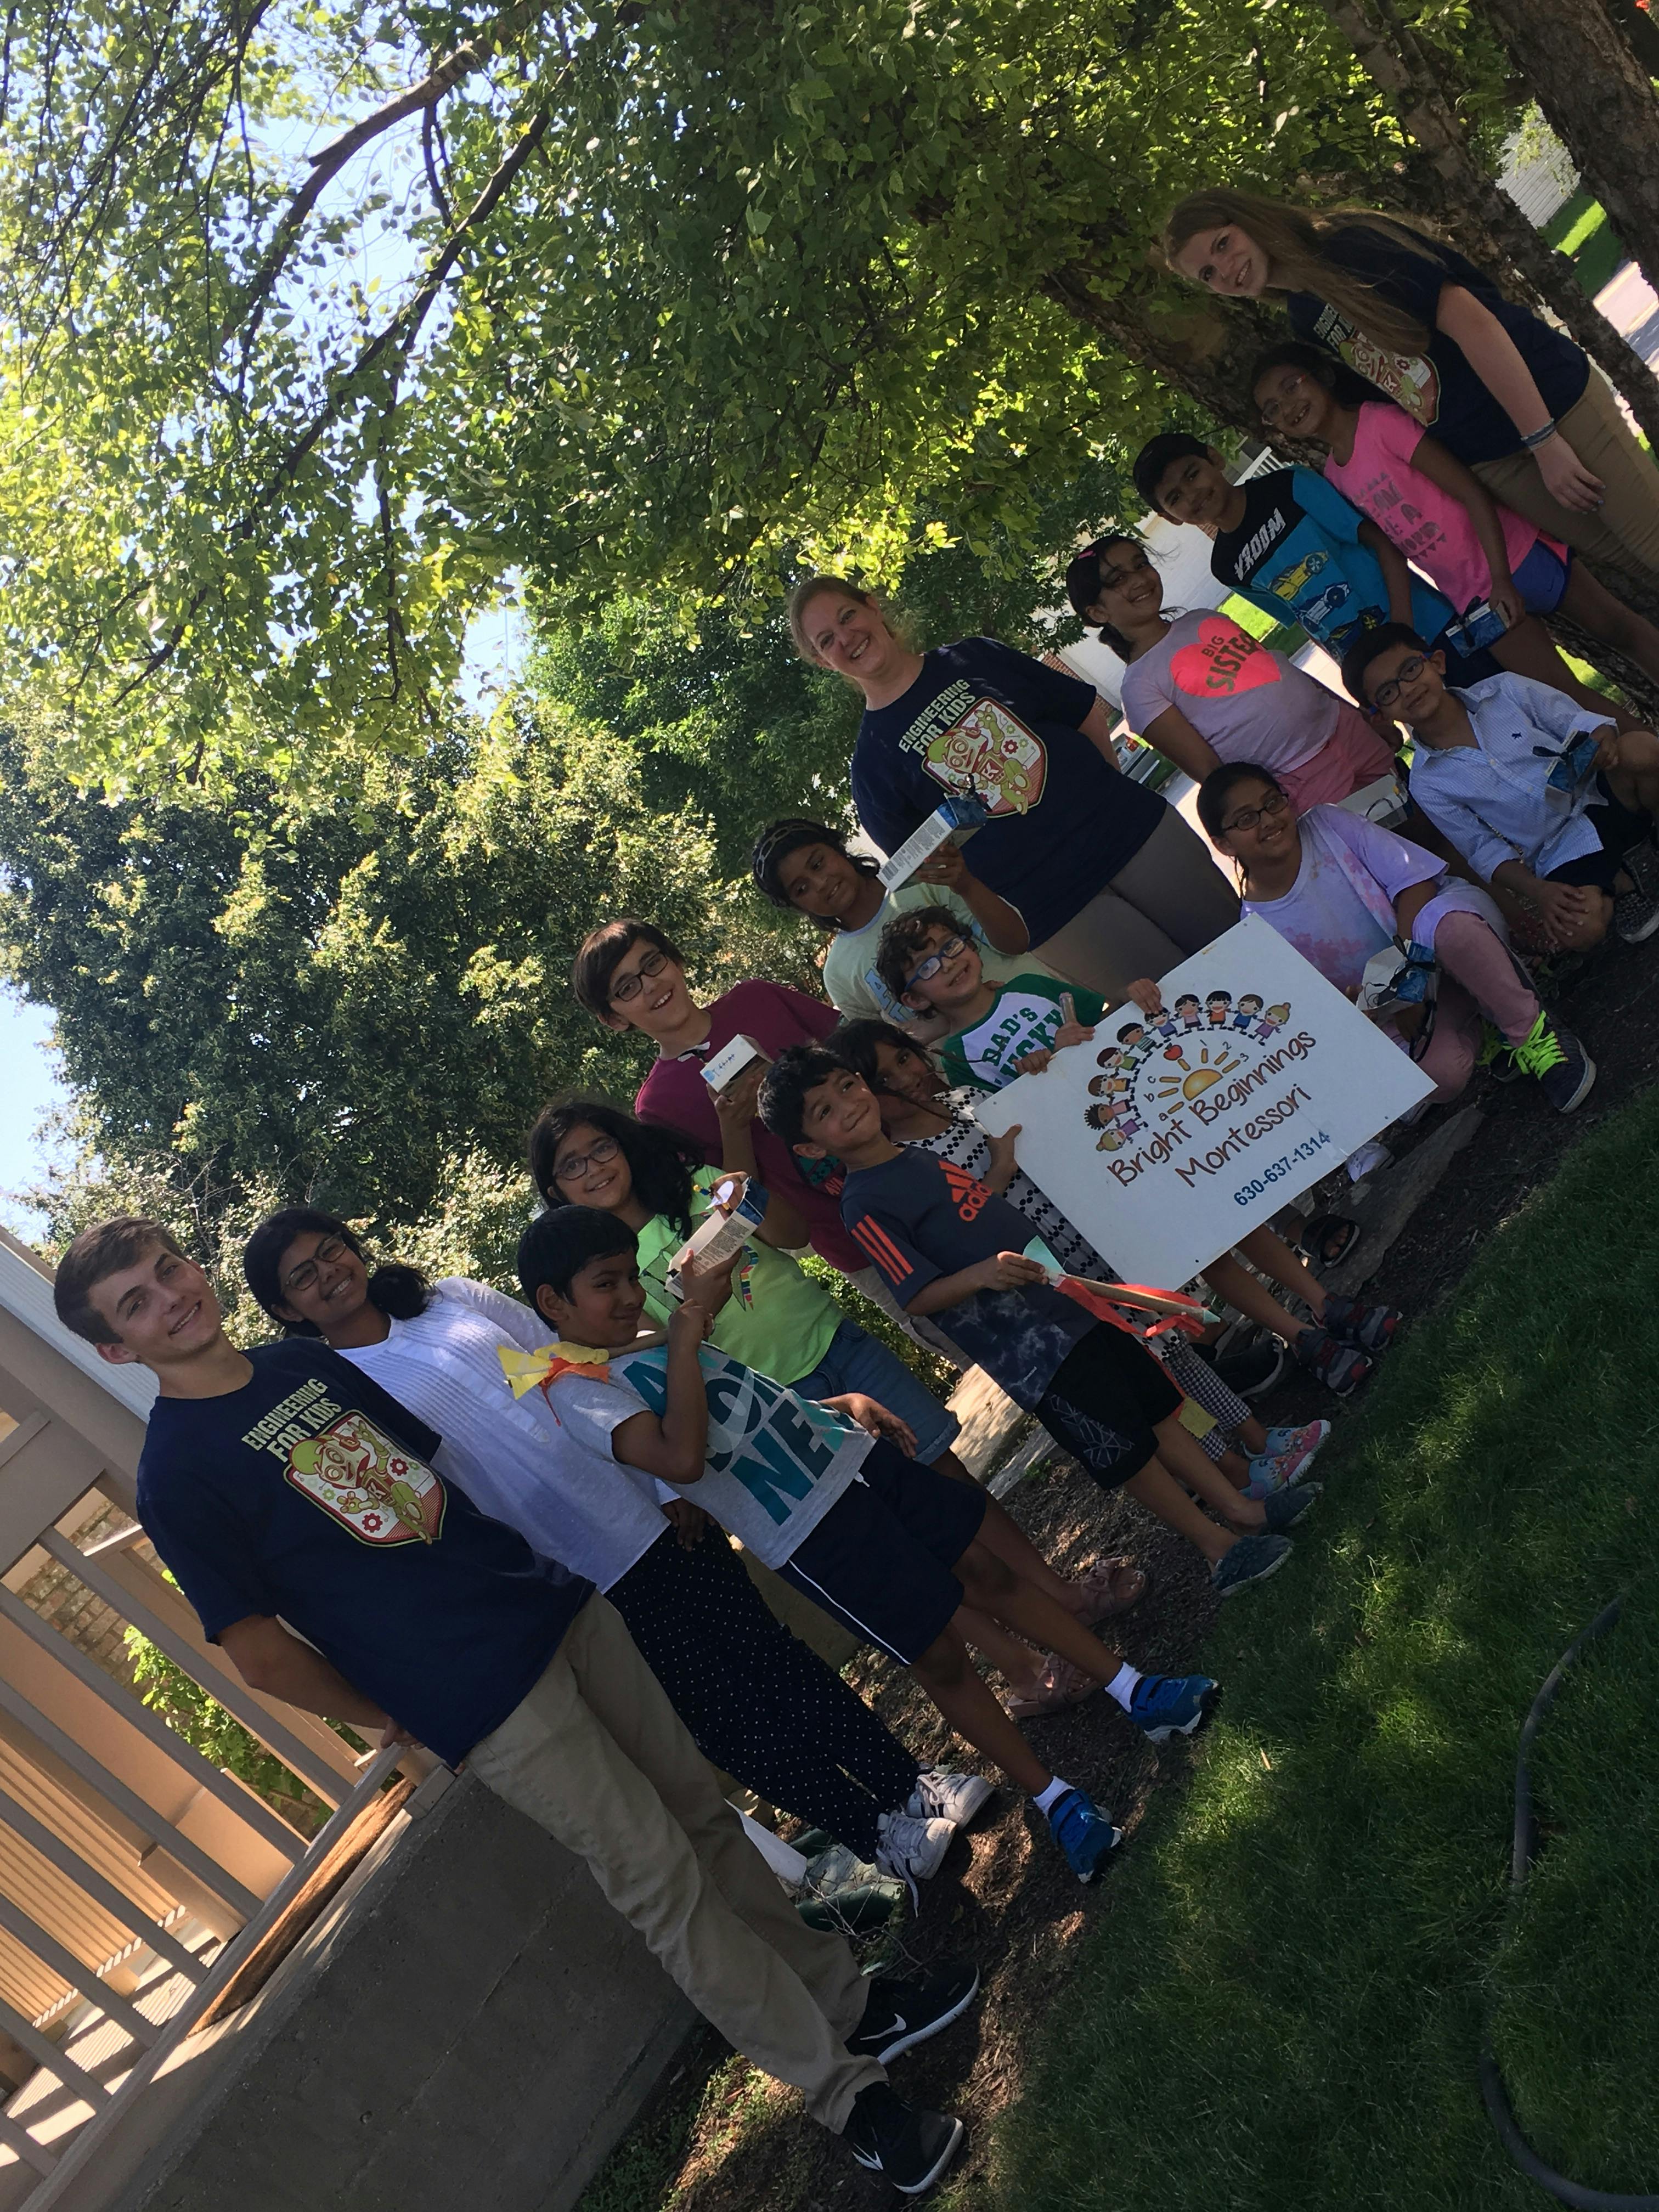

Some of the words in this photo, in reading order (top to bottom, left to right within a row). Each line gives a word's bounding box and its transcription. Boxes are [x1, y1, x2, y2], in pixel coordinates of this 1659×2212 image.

[1234, 507, 1286, 581] VROOM
[1201, 635, 1224, 657] BIG
[899, 679, 970, 753] ENGINEERING
[912, 724, 944, 756] FOR
[938, 692, 976, 726] KIDS
[981, 1007, 1039, 1067] DAD'S
[1222, 1040, 1232, 1052] 2
[1239, 1052, 1249, 1063] 3
[1107, 1119, 1193, 1187] Bright
[1189, 1031, 1317, 1126] Beginnings
[1143, 1092, 1155, 1103] b
[1147, 1075, 1156, 1084] c
[1158, 1111, 1169, 1121] a
[1175, 1084, 1312, 1188] Montessori
[1233, 1130, 1331, 1206] 630-637-1314
[958, 1181, 992, 1222] adid
[242, 1378, 328, 1451] ENGINEERING
[266, 1424, 312, 1463] FOR
[298, 1398, 342, 1430] KIDS
